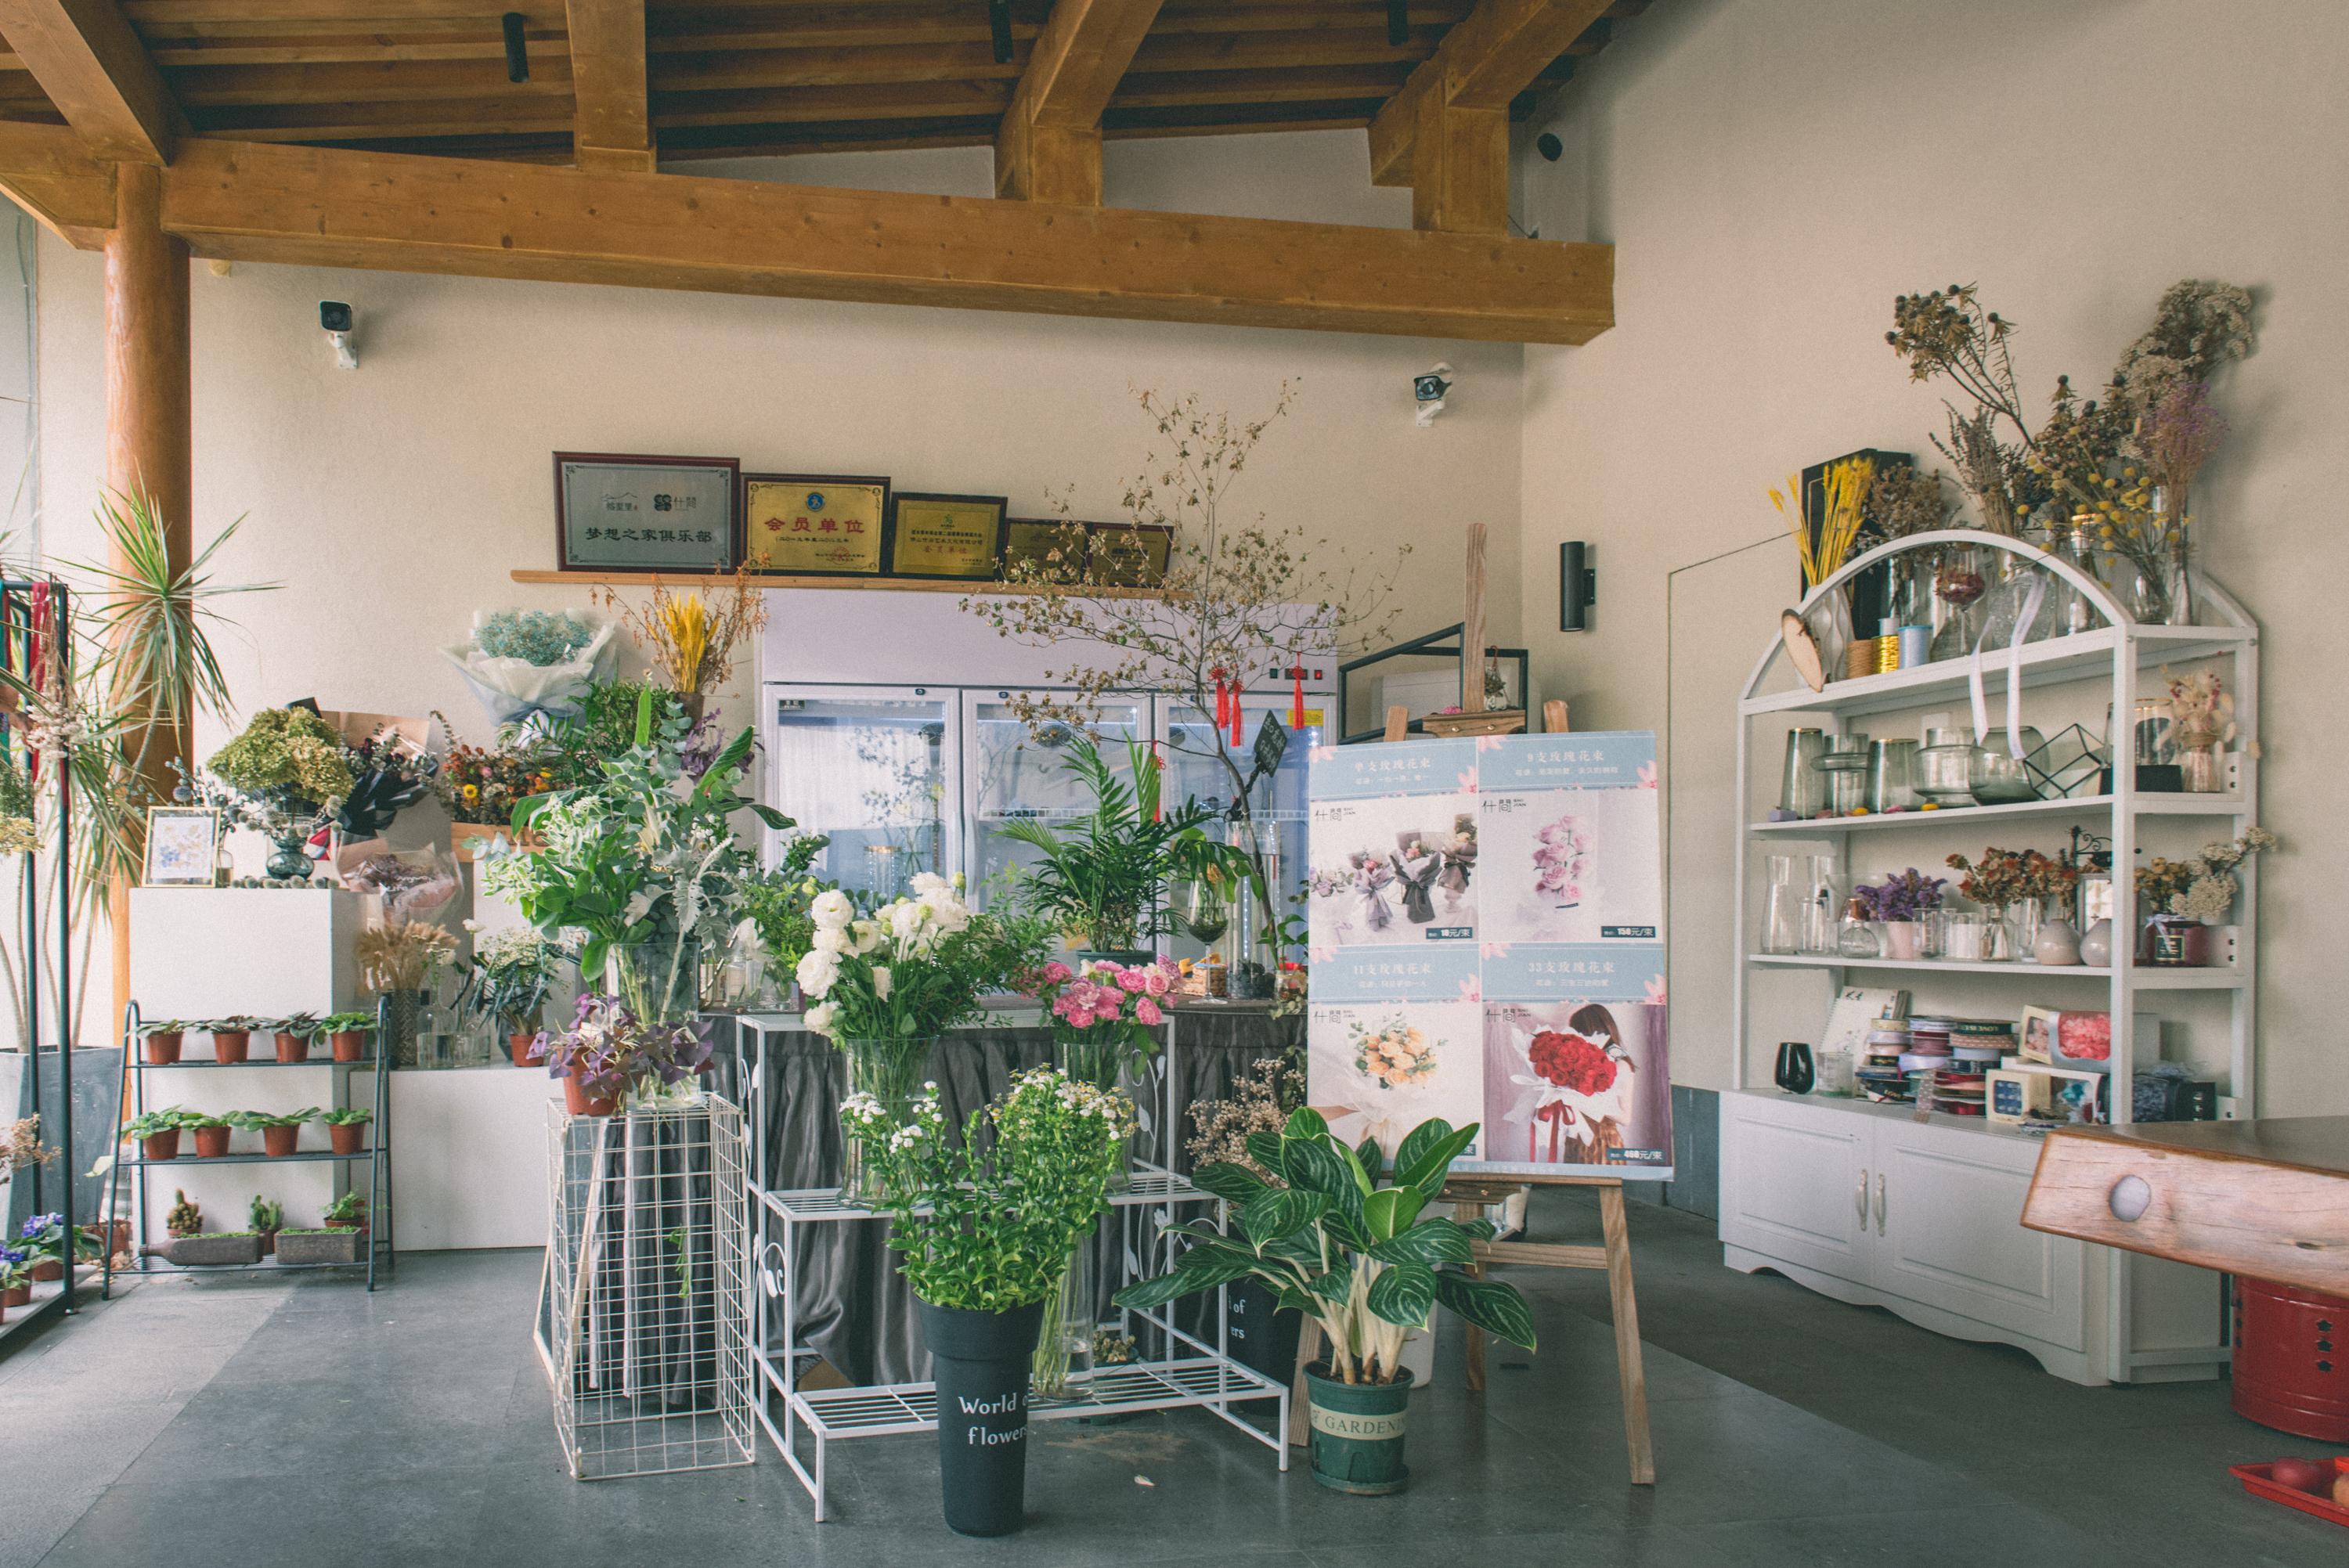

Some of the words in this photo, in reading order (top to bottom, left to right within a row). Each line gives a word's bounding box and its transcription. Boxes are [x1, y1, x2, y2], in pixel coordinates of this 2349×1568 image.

[764, 517, 865, 534] 会员单位
[585, 527, 712, 543] 梦想之家俱乐部
[958, 1392, 1017, 1415] World
